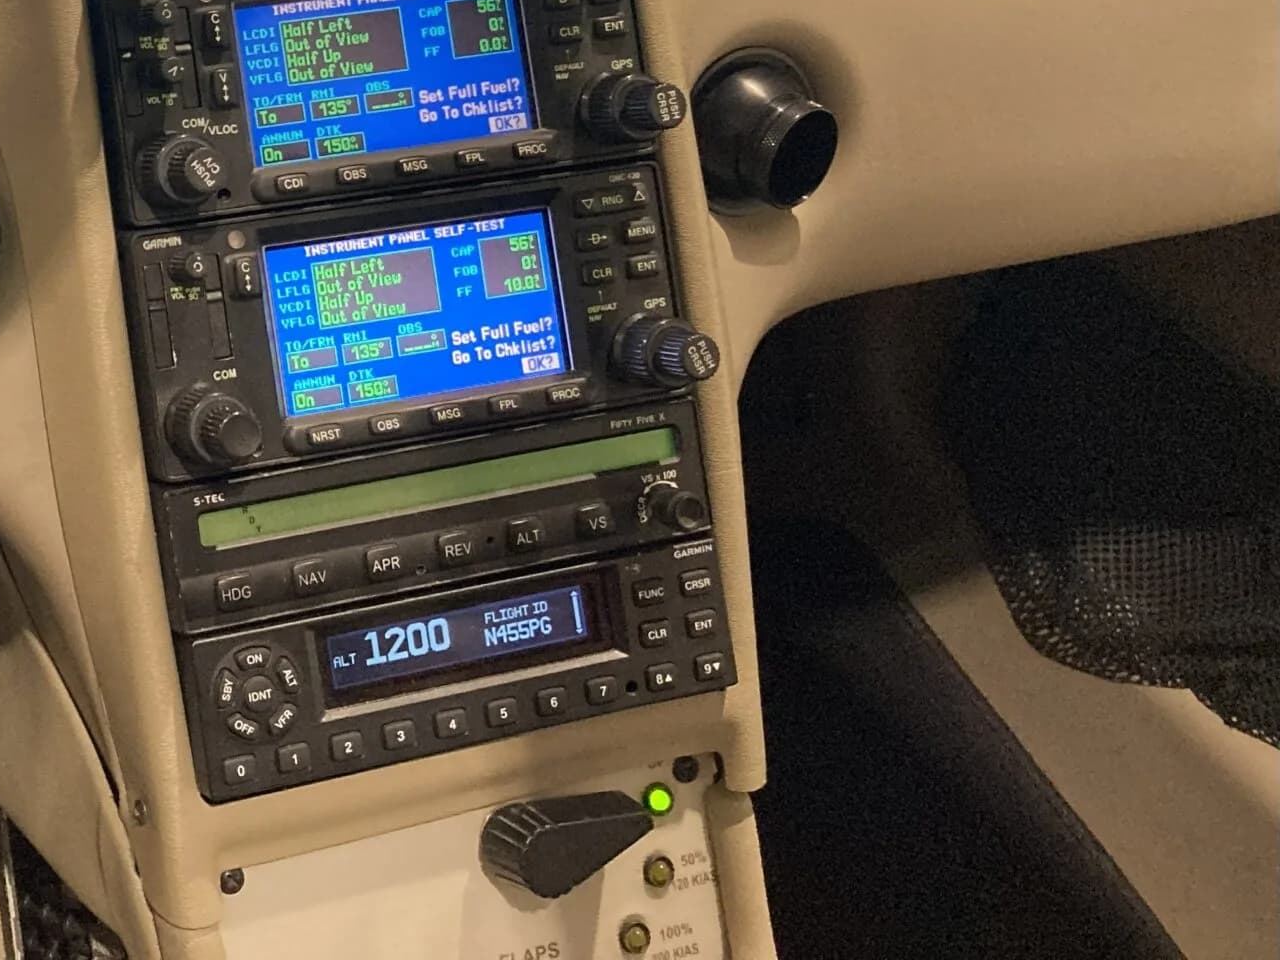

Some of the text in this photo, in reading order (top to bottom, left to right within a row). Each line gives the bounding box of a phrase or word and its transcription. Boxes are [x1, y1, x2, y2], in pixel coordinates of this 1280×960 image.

[243, 18, 352, 41] LCDI Half Left
[560, 26, 580, 38] CLR
[605, 21, 624, 31] ENT
[611, 59, 633, 69] GPS
[420, 79, 520, 104] Set Full Fuel?
[495, 116, 522, 130] OK?
[518, 144, 547, 154] PROC
[466, 152, 485, 163] FPL
[403, 159, 428, 172] MSG
[344, 169, 366, 180] OBS
[284, 178, 304, 190] CDI
[628, 225, 656, 238] MENU
[593, 267, 612, 278] CLR
[638, 261, 657, 272] ENT
[644, 298, 666, 309] GPS
[213, 369, 237, 380] COM
[377, 419, 400, 431] OBS
[313, 429, 341, 441] NRST
[590, 516, 607, 530] VS
[517, 530, 540, 544] ALT
[445, 542, 471, 557] REV
[674, 543, 713, 559] GARMIN
[373, 557, 400, 573] APR
[299, 570, 327, 587] NAV
[685, 577, 711, 590] CRSR
[222, 586, 251, 601] HDG
[639, 587, 664, 599] FUNC
[484, 601, 548, 624] FLIGHT ID
[695, 619, 713, 631] ENT
[484, 617, 552, 647] N455PG
[648, 628, 667, 640] CLR
[364, 618, 451, 667] 1200
[247, 653, 263, 665] ON
[248, 689, 272, 703] IDNT
[659, 923, 693, 940] 100%
